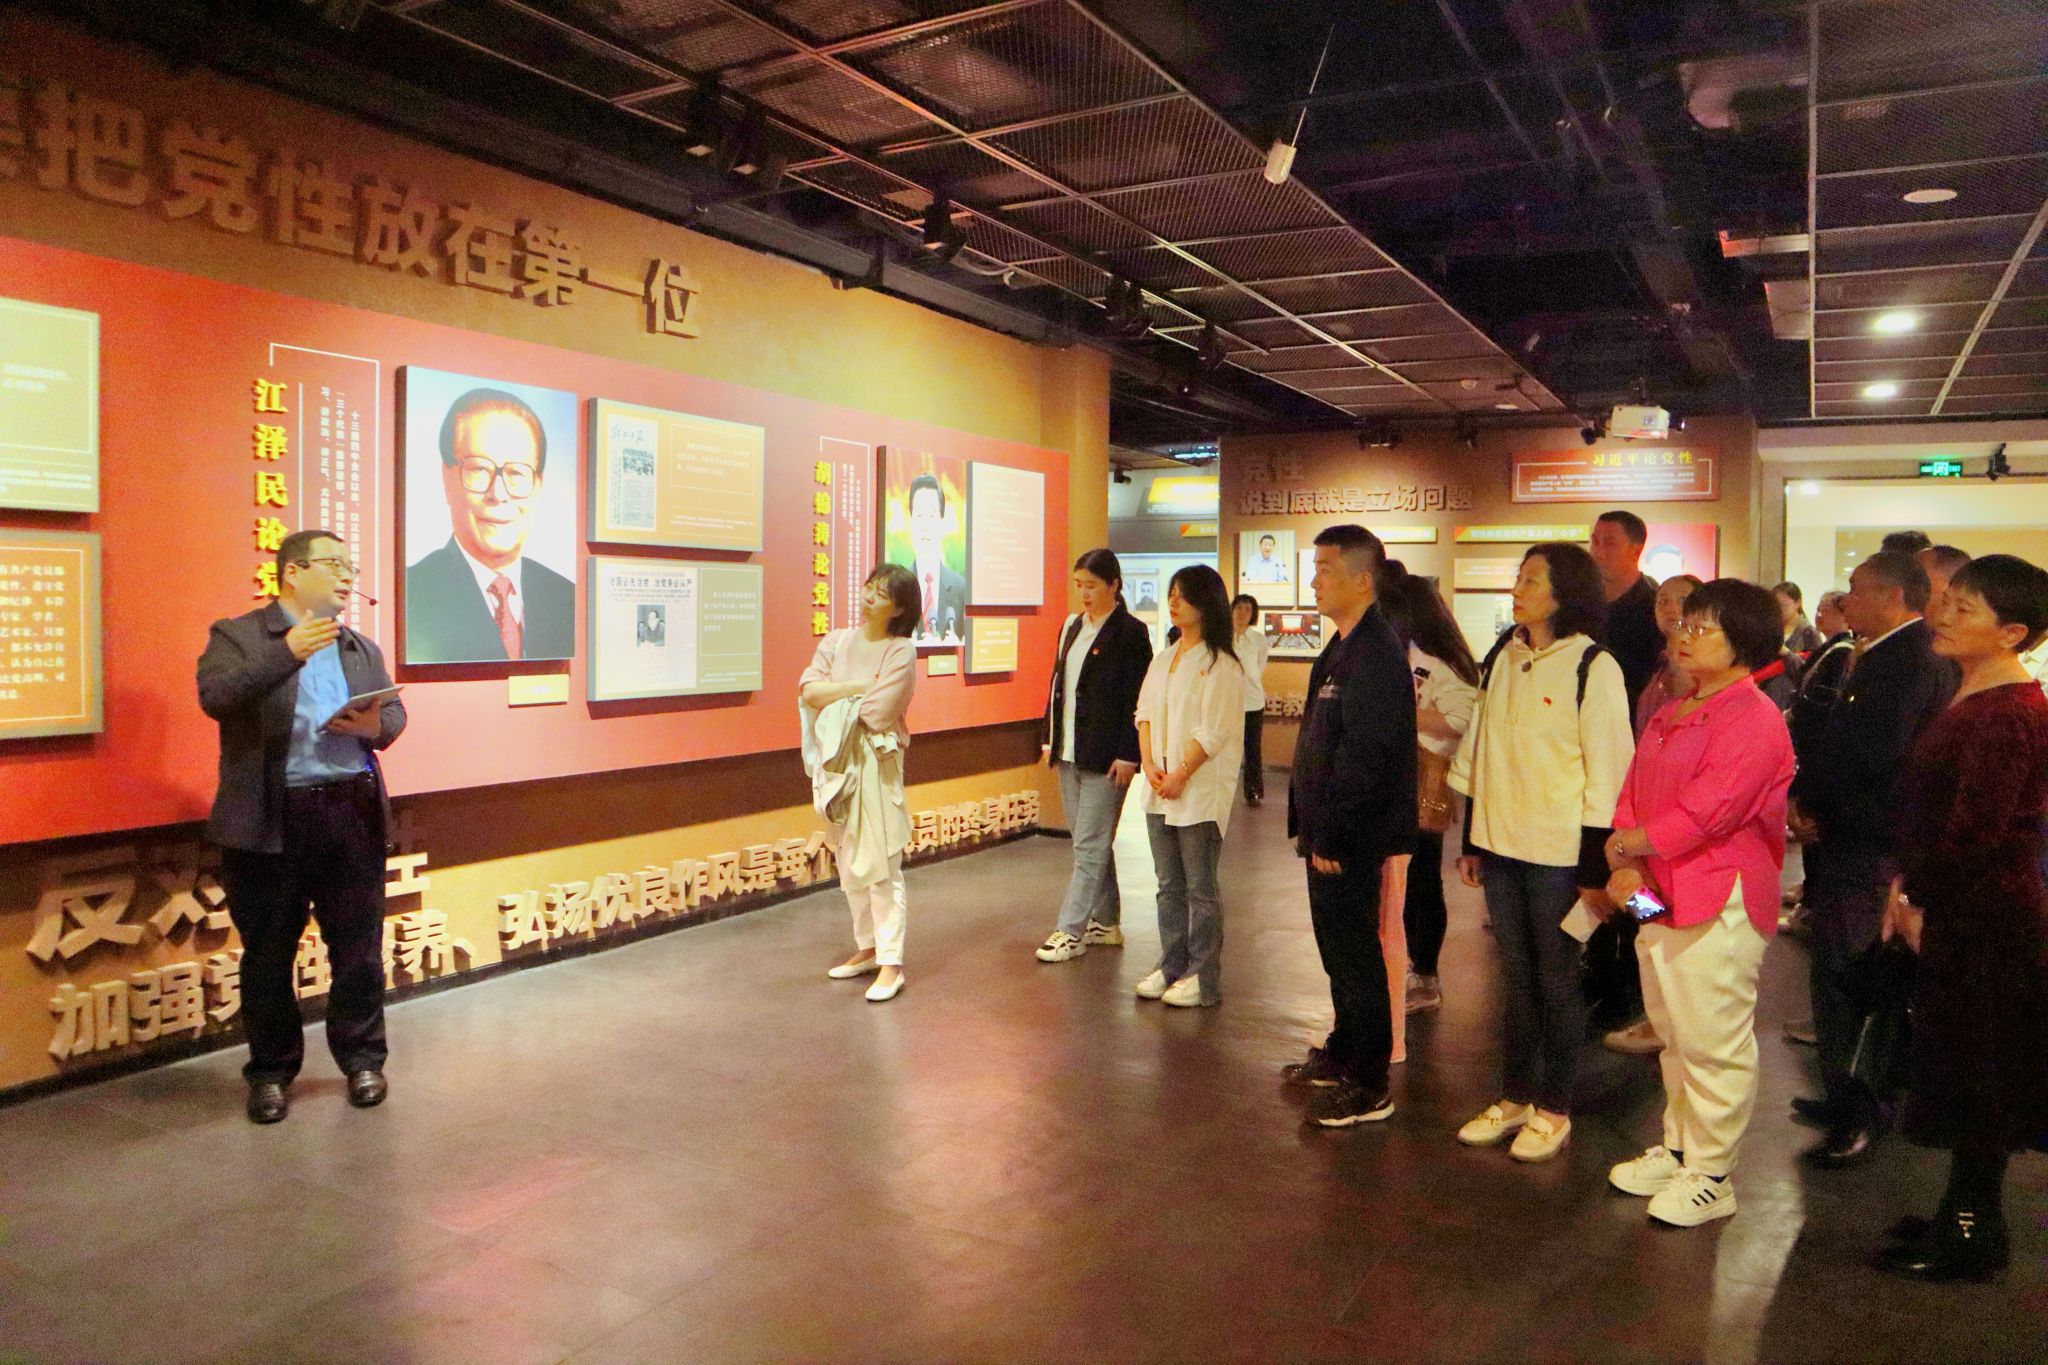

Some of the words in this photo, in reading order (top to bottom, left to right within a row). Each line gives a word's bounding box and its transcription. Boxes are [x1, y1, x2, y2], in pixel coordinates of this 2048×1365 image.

[0, 80, 701, 338] 把党性放在第一位
[1238, 484, 1472, 515] 说到底就是立场问题
[1593, 450, 1693, 467] 习近平论党性
[813, 460, 833, 637] 胡锦涛论党性
